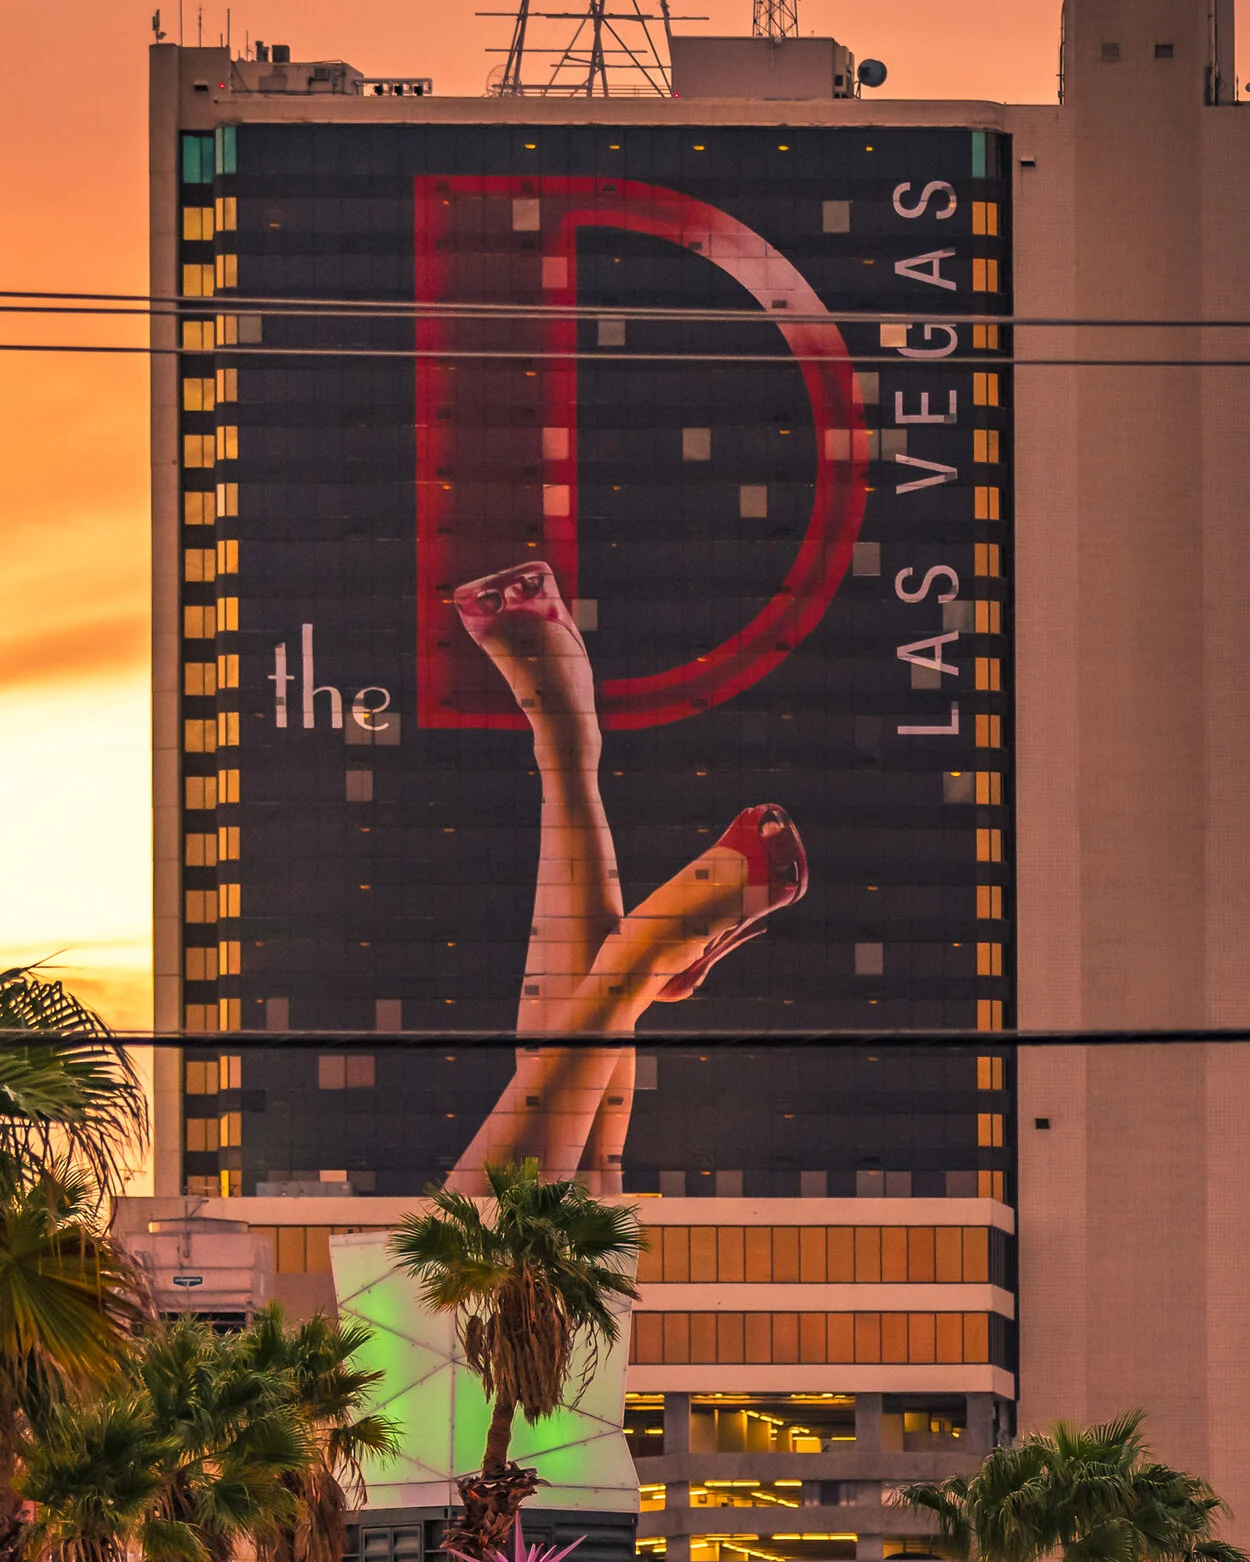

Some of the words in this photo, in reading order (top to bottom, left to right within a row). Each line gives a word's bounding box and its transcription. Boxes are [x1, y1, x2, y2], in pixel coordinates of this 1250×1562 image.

[268, 623, 391, 731] the
[413, 175, 869, 730] D
[892, 180, 958, 494] VEGAS
[895, 564, 960, 736] LAS
